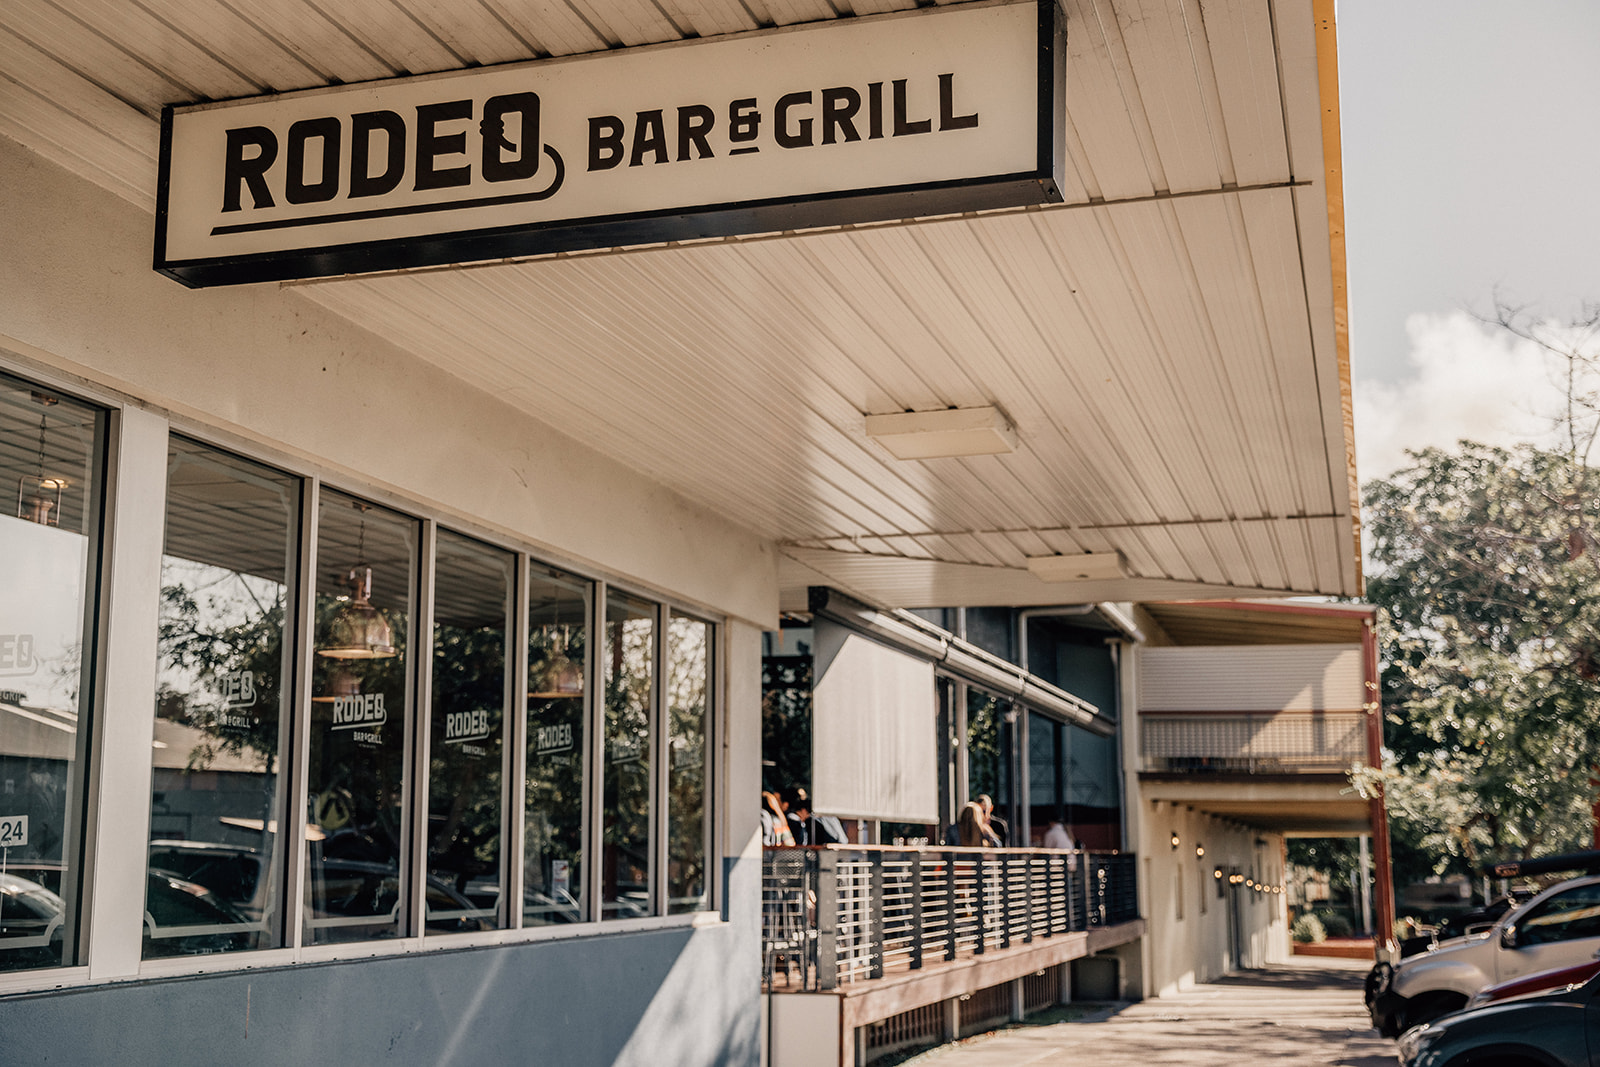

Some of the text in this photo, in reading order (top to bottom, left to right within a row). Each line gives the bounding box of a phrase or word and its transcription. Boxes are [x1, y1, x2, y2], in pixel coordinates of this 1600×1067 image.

[221, 91, 541, 213] RODEO
[332, 693, 384, 724] RODEO
[446, 709, 487, 738] RODEO
[537, 723, 571, 750] RODEO
[1, 820, 24, 842] 24
